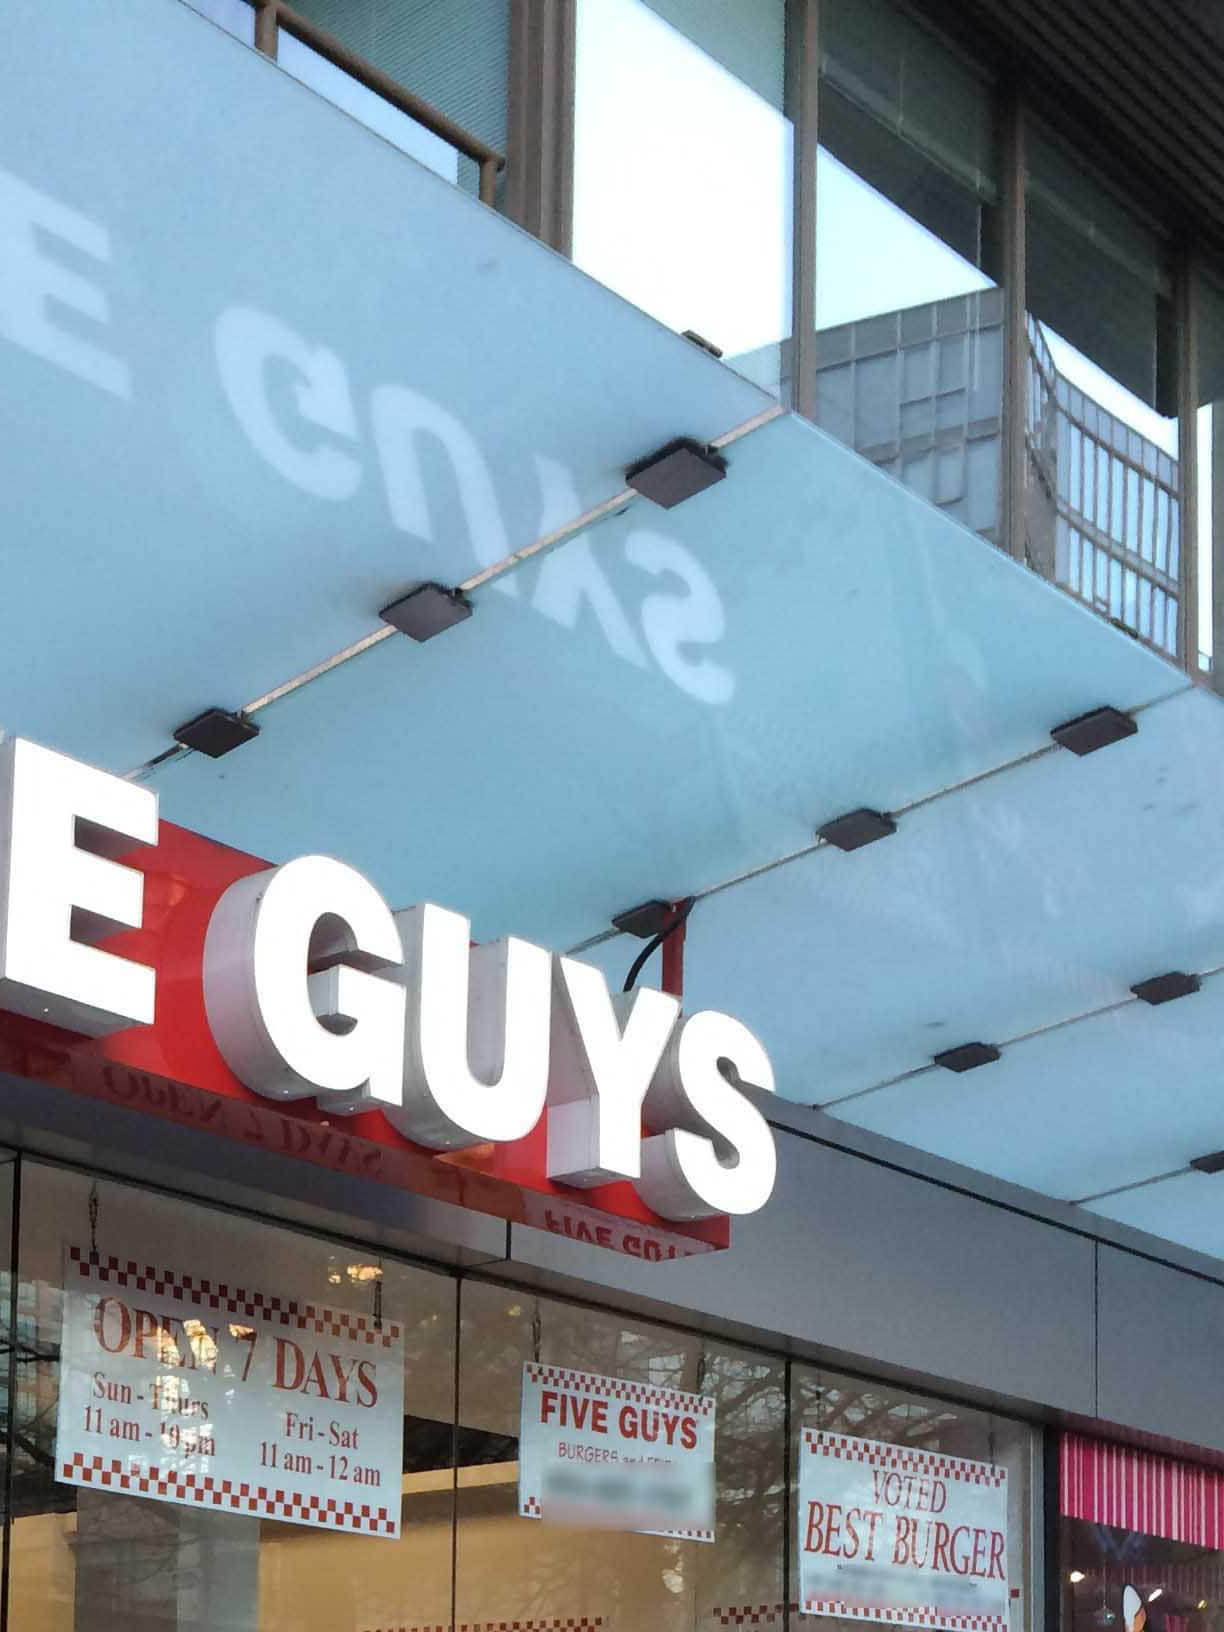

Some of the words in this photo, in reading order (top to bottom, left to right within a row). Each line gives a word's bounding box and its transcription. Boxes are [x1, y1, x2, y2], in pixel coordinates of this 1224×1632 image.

[206, 853, 779, 1222] GUYS
[93, 1370, 132, 1405] Sun
[229, 1322, 257, 1383] 7
[272, 1336, 379, 1410] DAYS
[84, 1404, 103, 1434] 11
[109, 1417, 140, 1441] am
[285, 1410, 314, 1441] Fri
[329, 1420, 360, 1450] Sat
[540, 1389, 609, 1434] FIVE
[618, 1405, 698, 1450] GUYS
[260, 1440, 278, 1468] 11
[284, 1451, 313, 1475] am
[329, 1454, 349, 1481] 12
[353, 1464, 381, 1487] am
[872, 1469, 947, 1514] VOTED
[803, 1500, 884, 1562] BEST
[892, 1514, 1006, 1581] BURGER
